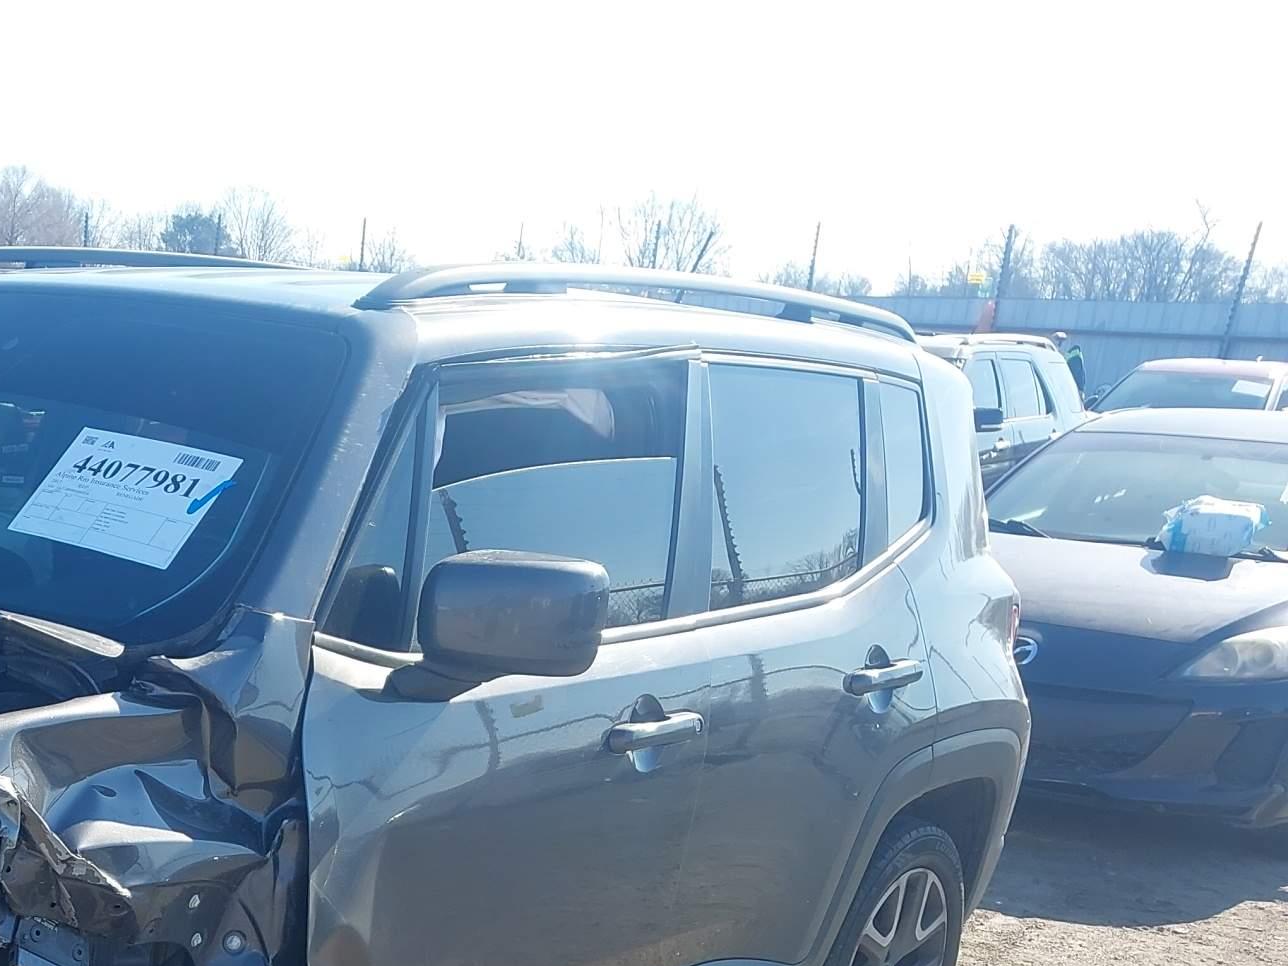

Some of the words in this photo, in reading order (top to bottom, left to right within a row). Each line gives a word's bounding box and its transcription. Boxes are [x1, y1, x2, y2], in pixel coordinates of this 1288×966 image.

[73, 454, 202, 498] 44077981
[90, 477, 122, 490] Insurance
[122, 483, 150, 496] Services
